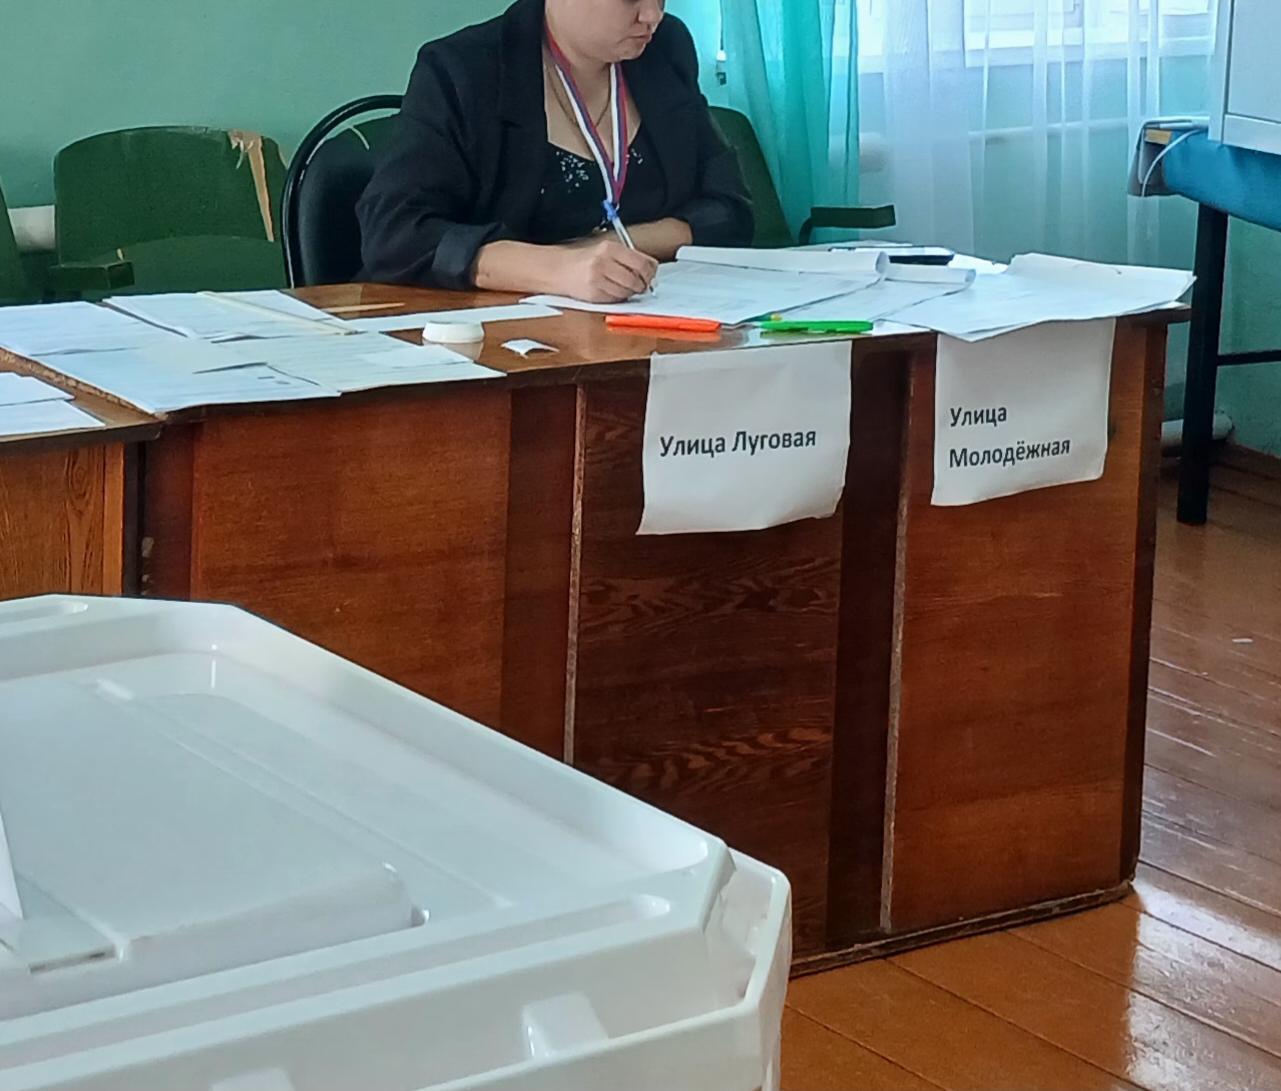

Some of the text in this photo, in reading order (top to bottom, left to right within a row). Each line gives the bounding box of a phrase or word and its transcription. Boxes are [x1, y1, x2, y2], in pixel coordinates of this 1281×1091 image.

[950, 406, 1007, 428] Улица
[660, 429, 817, 458] Улица Луговая
[949, 437, 1071, 469] Молодёжная
